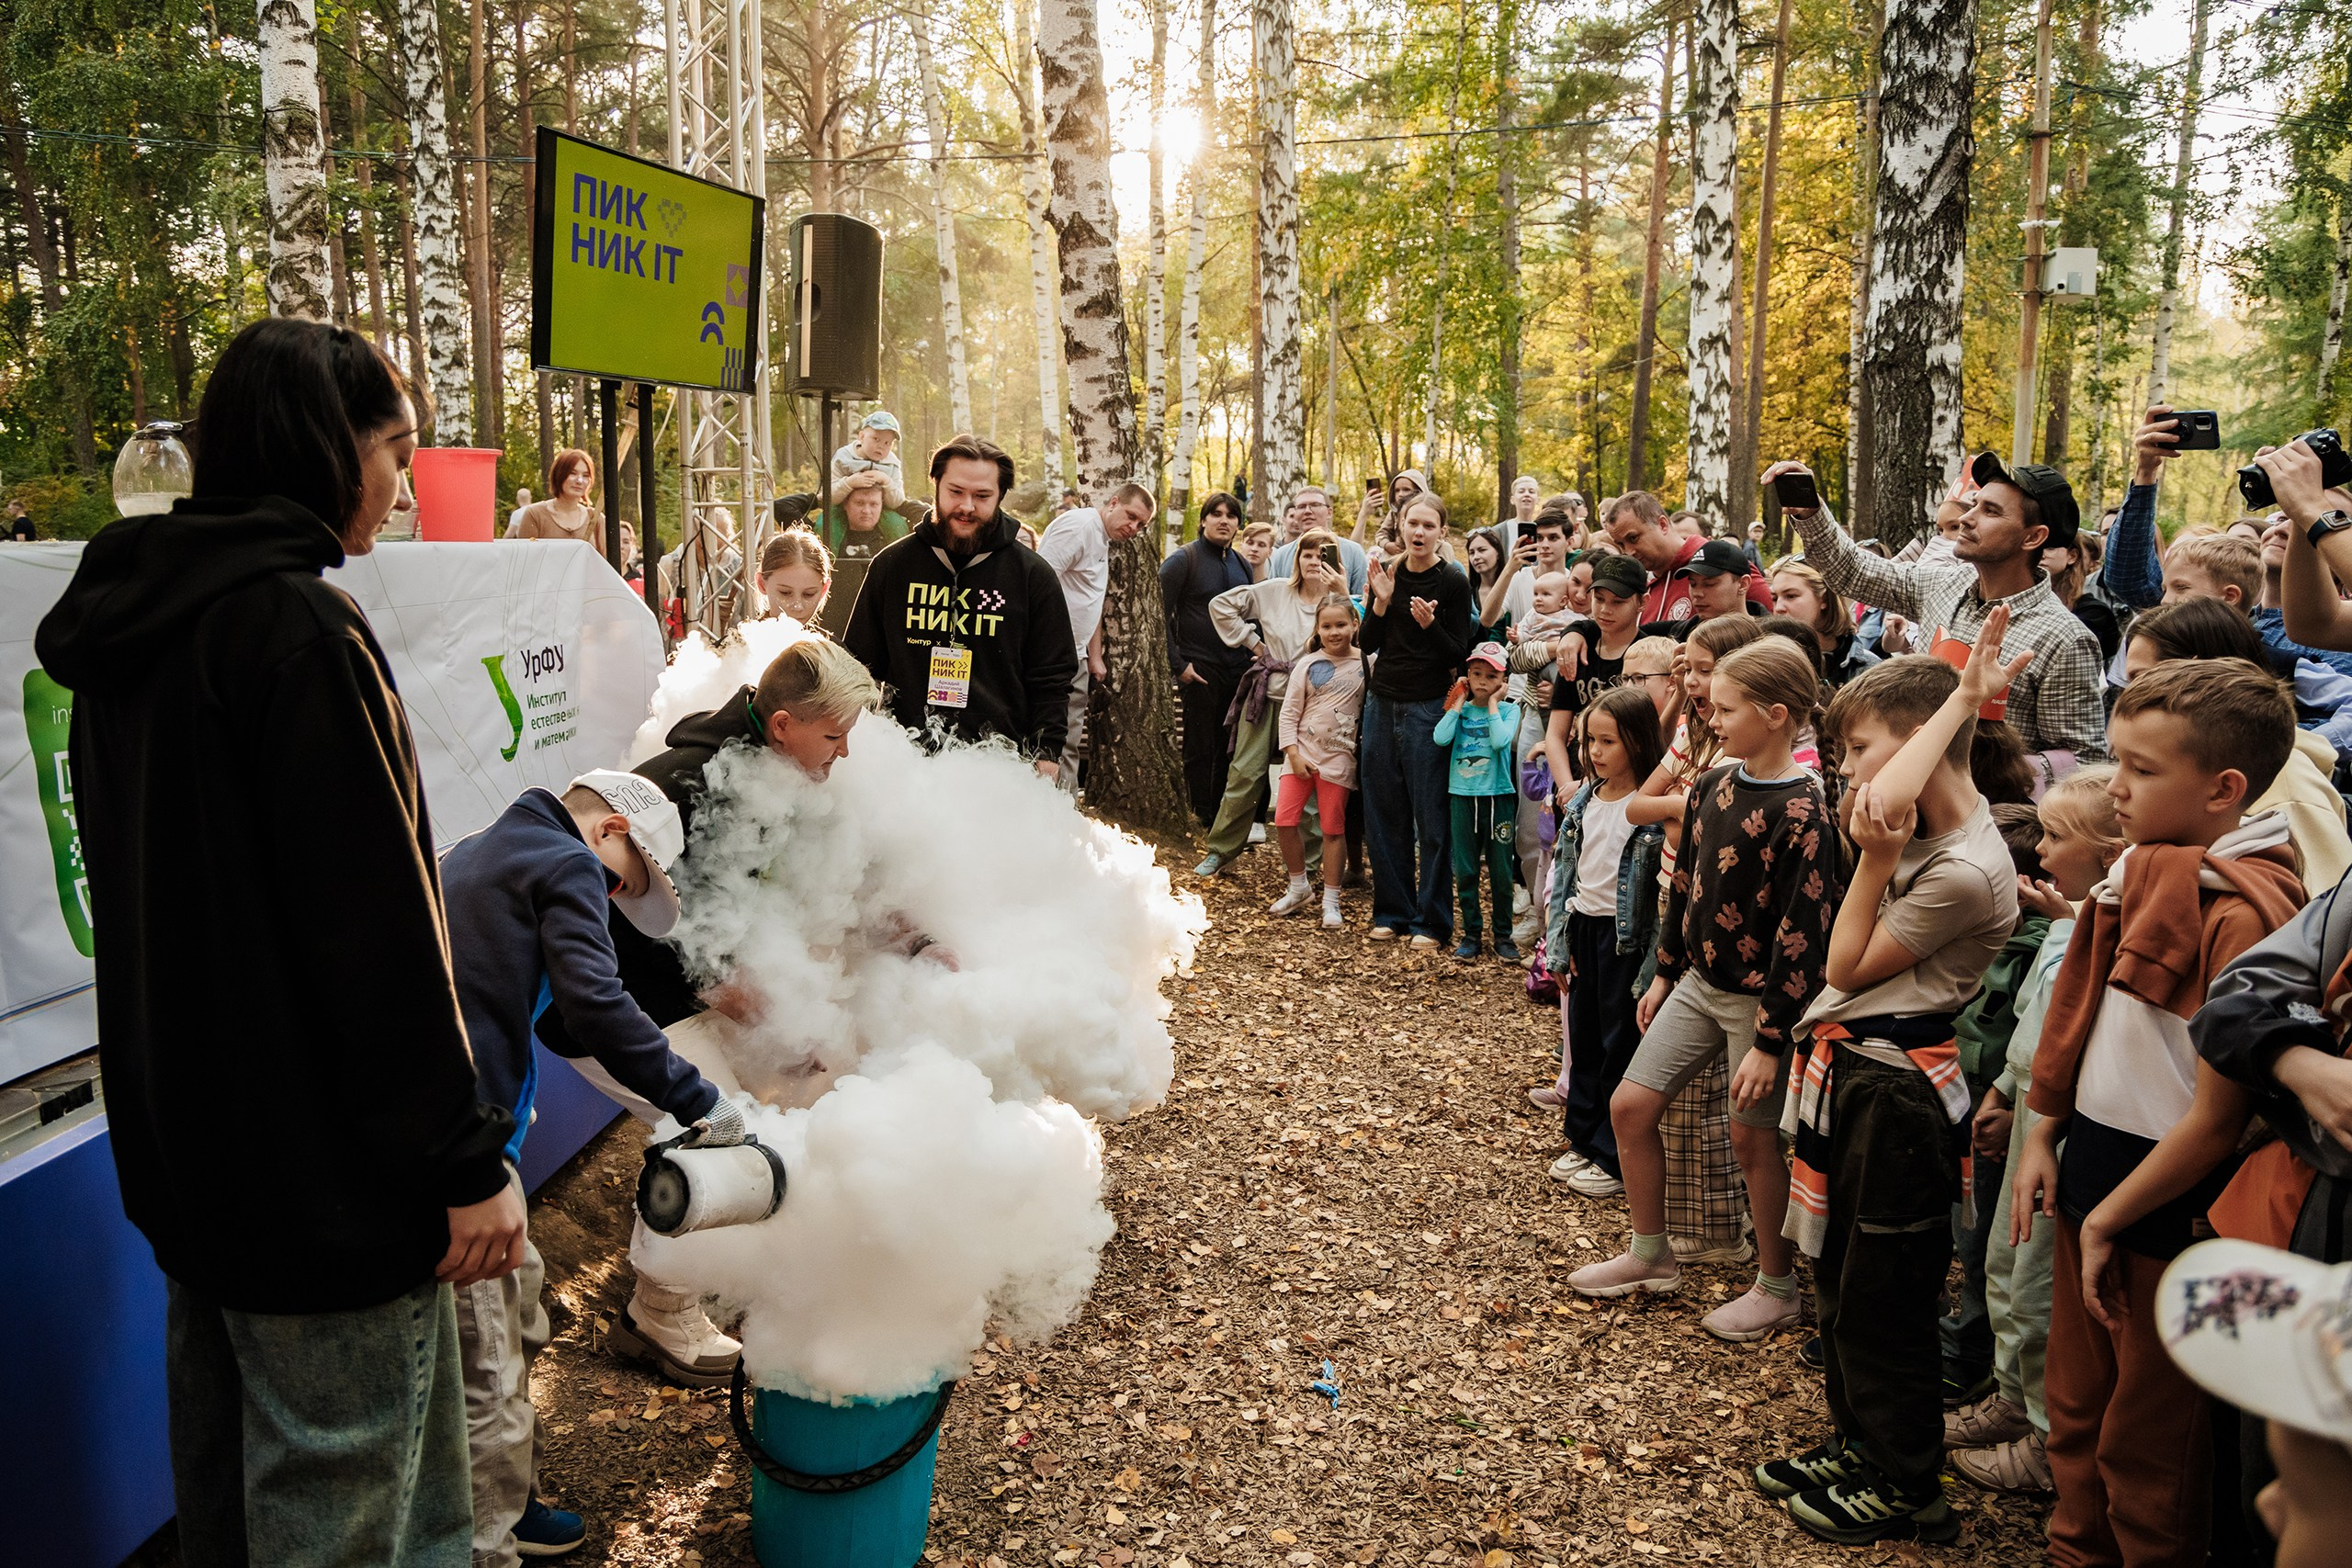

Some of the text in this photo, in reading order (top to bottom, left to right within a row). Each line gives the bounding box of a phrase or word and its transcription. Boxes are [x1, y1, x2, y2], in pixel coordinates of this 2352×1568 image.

[573, 172, 648, 231] ПИК
[571, 222, 684, 284] НИК IT
[907, 582, 971, 610] ПИК
[906, 607, 1004, 637] НИК IT
[907, 637, 932, 646] Контур
[520, 644, 564, 683] УрФУ
[933, 659, 956, 669] ПИК
[933, 668, 967, 679] НИК IT
[526, 691, 566, 709] Институт
[534, 739, 539, 750] и
[600, 778, 663, 817] CUS
